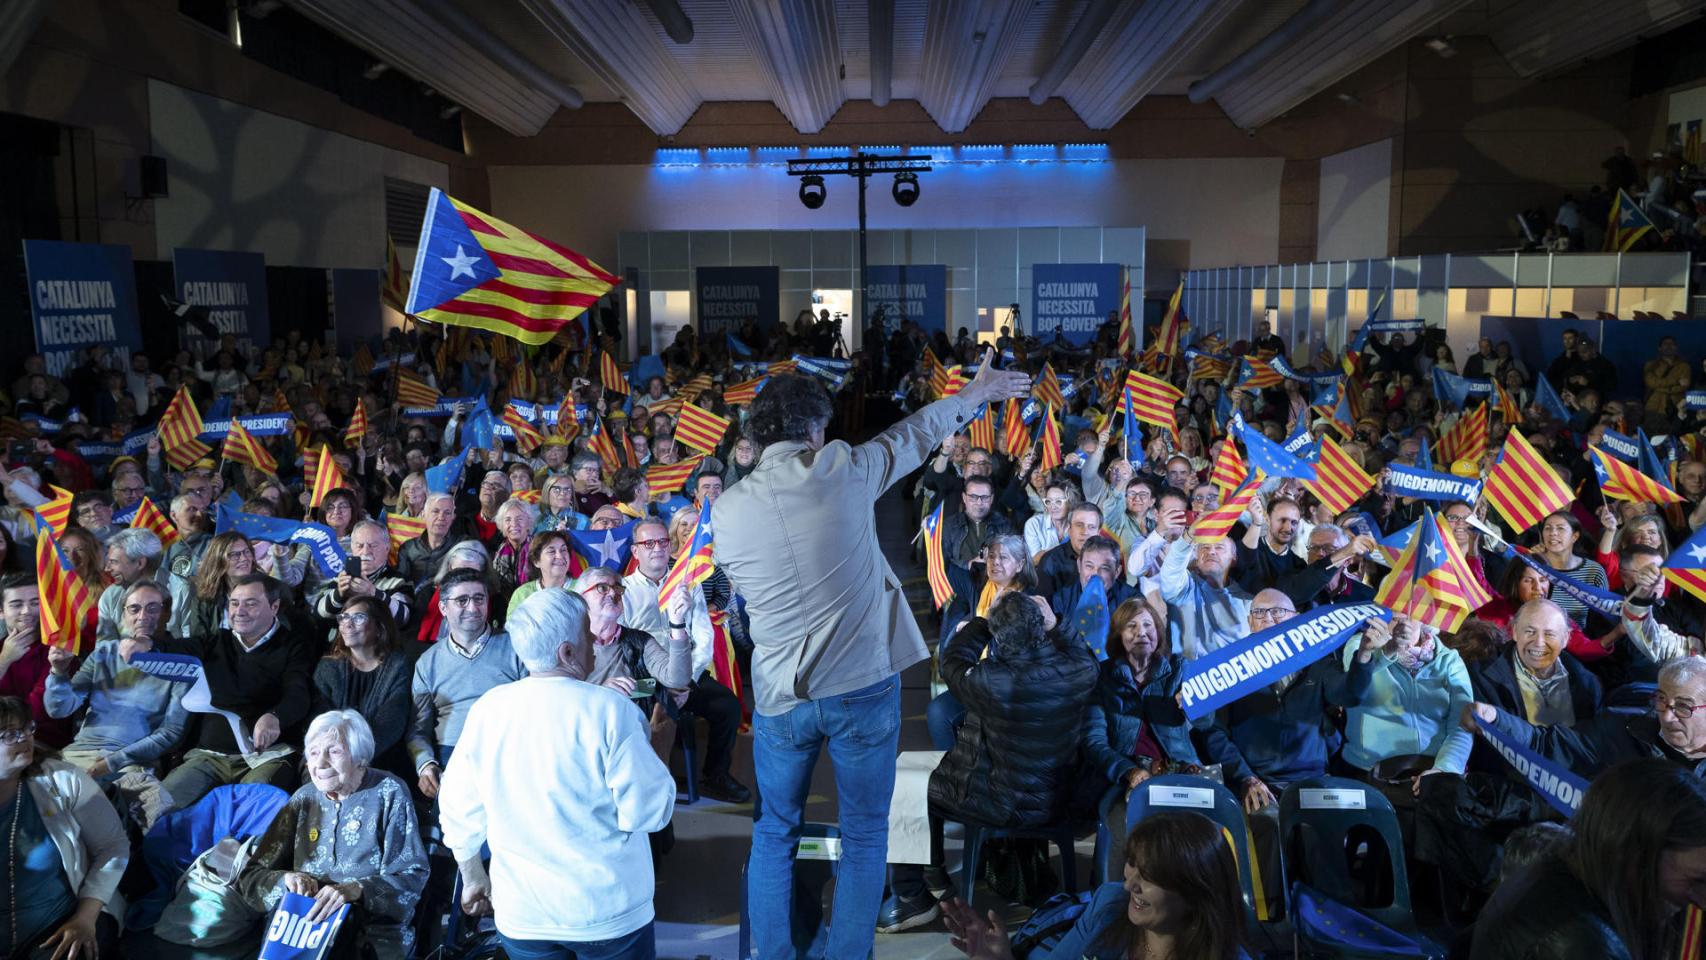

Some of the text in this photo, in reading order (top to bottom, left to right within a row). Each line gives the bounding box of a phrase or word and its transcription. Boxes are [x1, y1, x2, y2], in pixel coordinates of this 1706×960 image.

[36, 280, 116, 309] CATALUNYA
[184, 281, 248, 306] CATALUNYA
[703, 285, 760, 300] CATALUNYA
[1038, 283, 1099, 298] CATALUNYA
[704, 303, 759, 317] NECESSITA
[1038, 300, 1096, 315] NECESSITA
[40, 314, 117, 345] NECESSITA
[1603, 434, 1640, 458] PUIGDE
[1385, 467, 1472, 495] PUIGDEMONT
[1181, 603, 1386, 708] PUIGDEMONT PRESIDENT
[268, 910, 329, 949] PUIG
